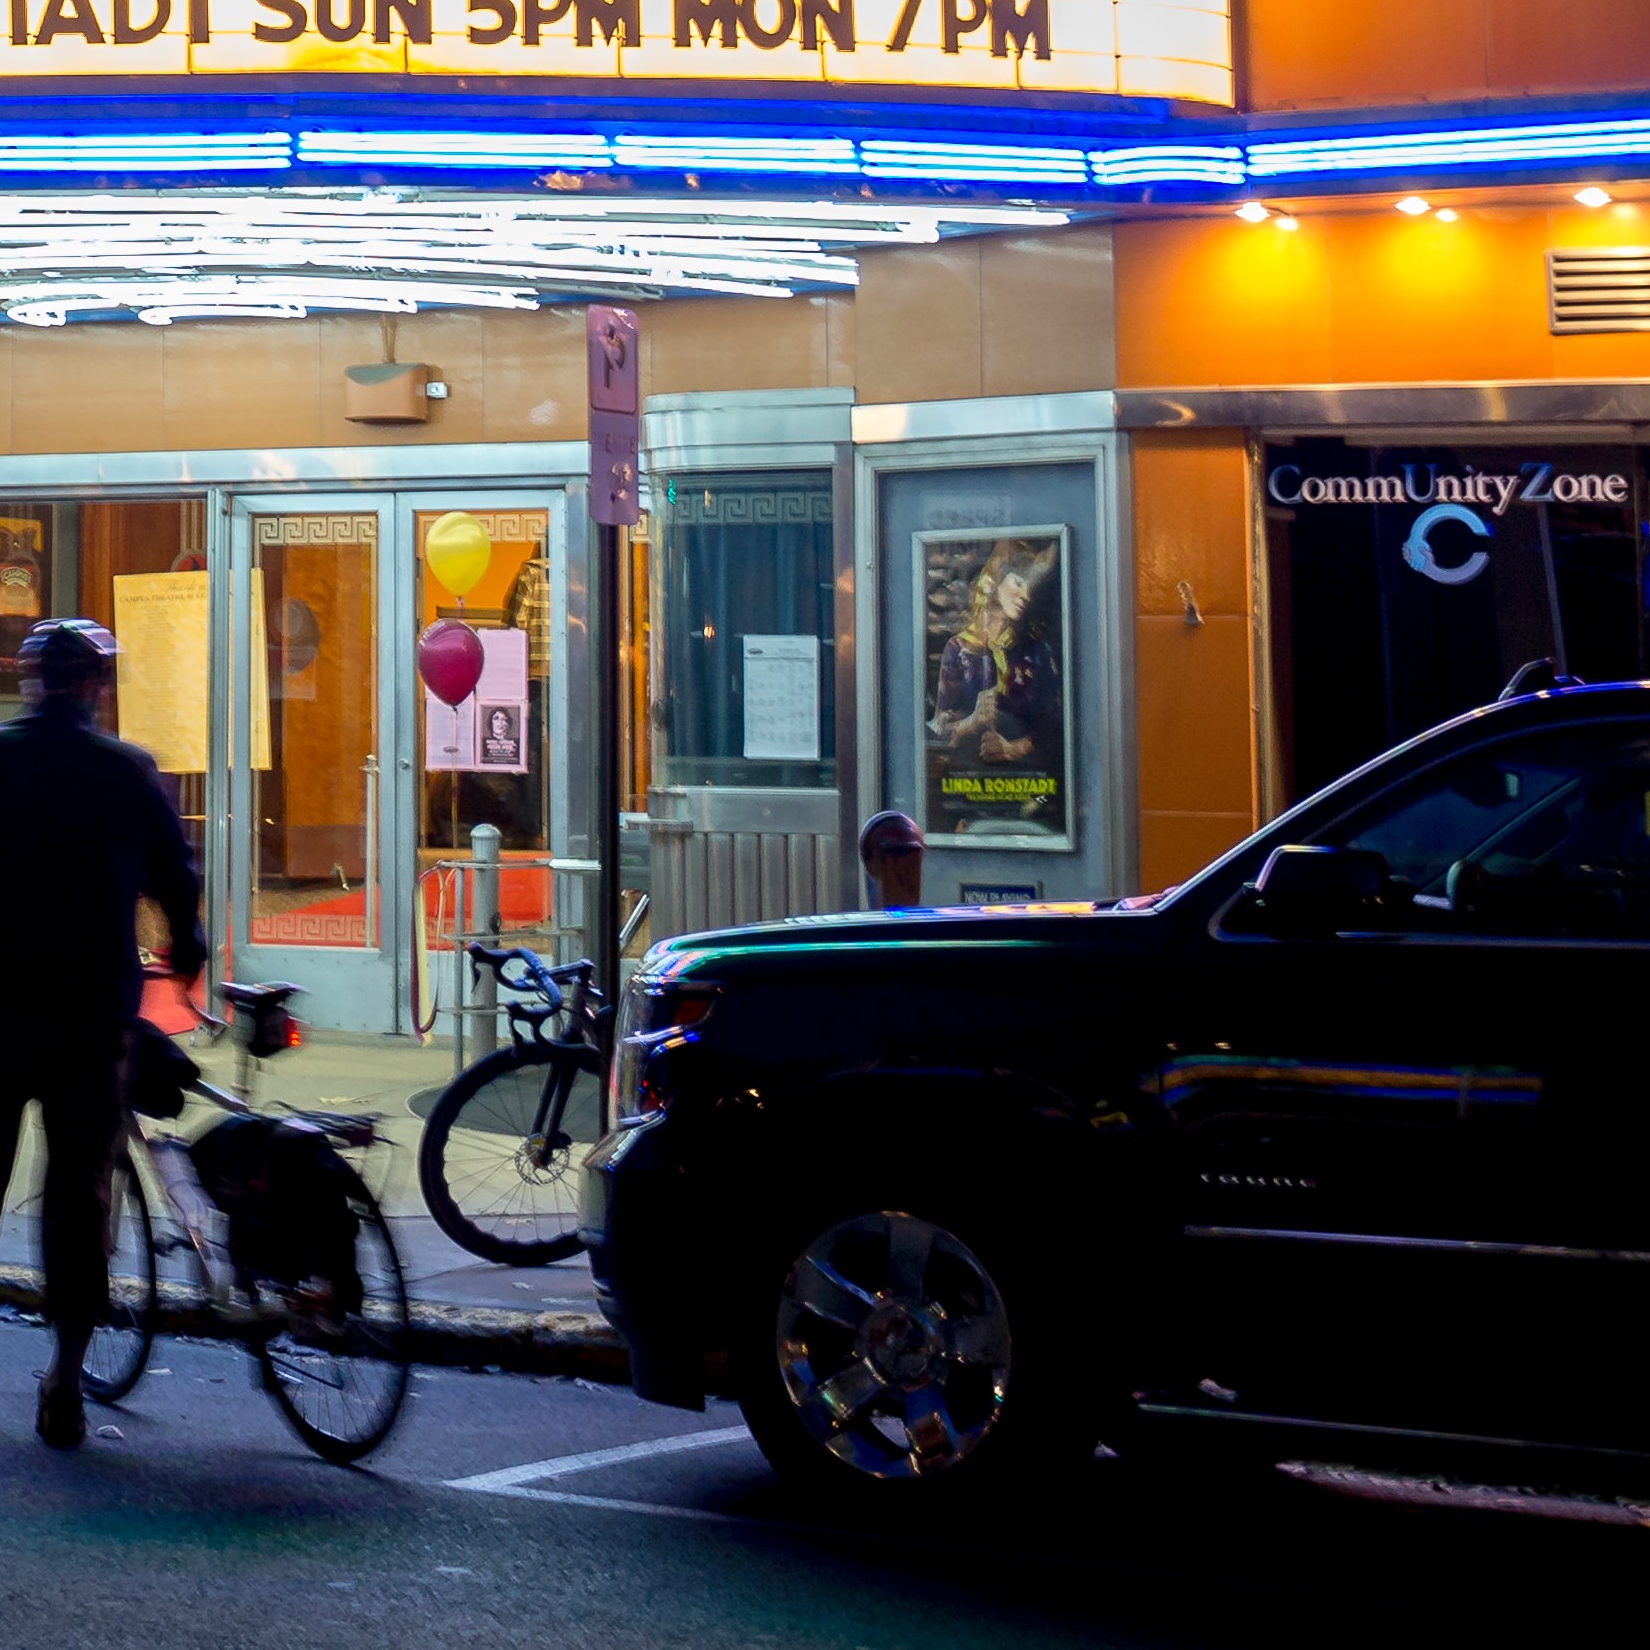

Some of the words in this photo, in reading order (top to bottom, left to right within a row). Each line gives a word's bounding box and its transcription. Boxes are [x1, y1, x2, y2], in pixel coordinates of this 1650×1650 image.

[603, 334, 626, 389] P
[941, 778, 982, 794] LINDA
[984, 778, 1056, 795] RONSTADT
[964, 891, 988, 904] NOW
